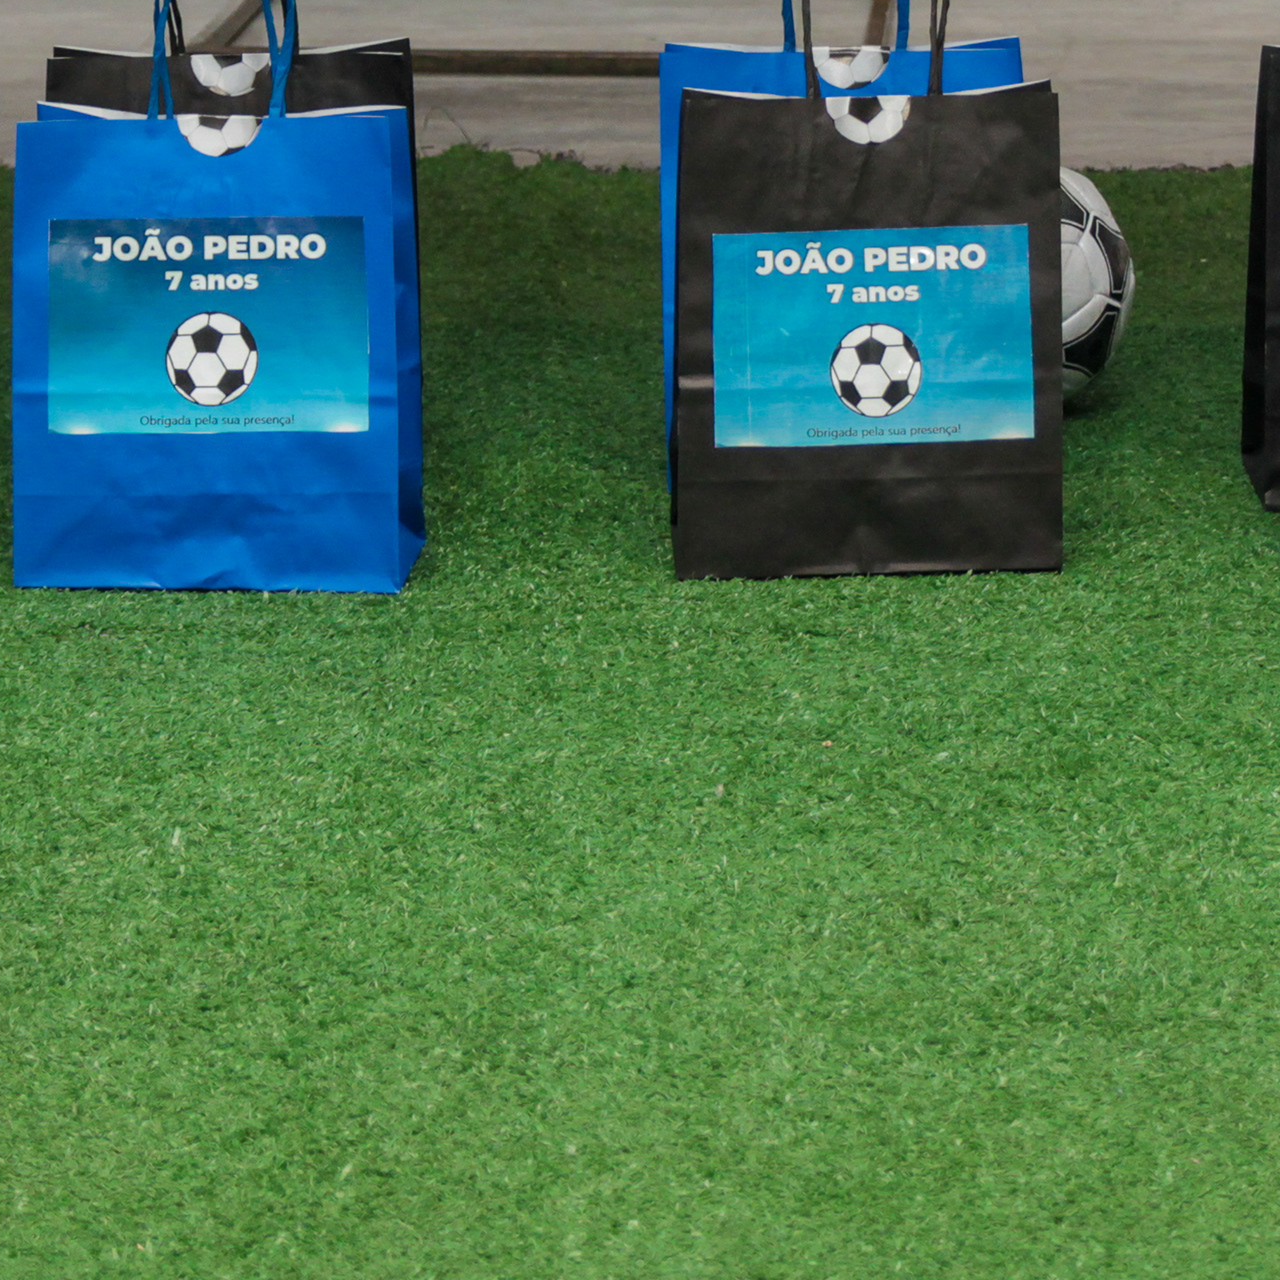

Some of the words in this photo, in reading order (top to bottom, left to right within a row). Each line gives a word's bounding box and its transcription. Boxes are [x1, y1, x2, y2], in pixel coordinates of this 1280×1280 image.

[92, 228, 193, 262] JOÃO
[204, 233, 327, 260] PEDRO
[755, 242, 853, 276] JOÃO
[864, 243, 987, 272] PEDRO
[164, 271, 182, 290] 7
[190, 273, 259, 290] anos
[827, 284, 844, 303] 7
[852, 285, 919, 303] anos
[140, 415, 190, 427] Obrigada
[195, 415, 218, 427] pela
[244, 415, 294, 426] presença!
[807, 428, 858, 439] Obrigada
[862, 427, 884, 438] pela
[910, 424, 961, 437] presença!
